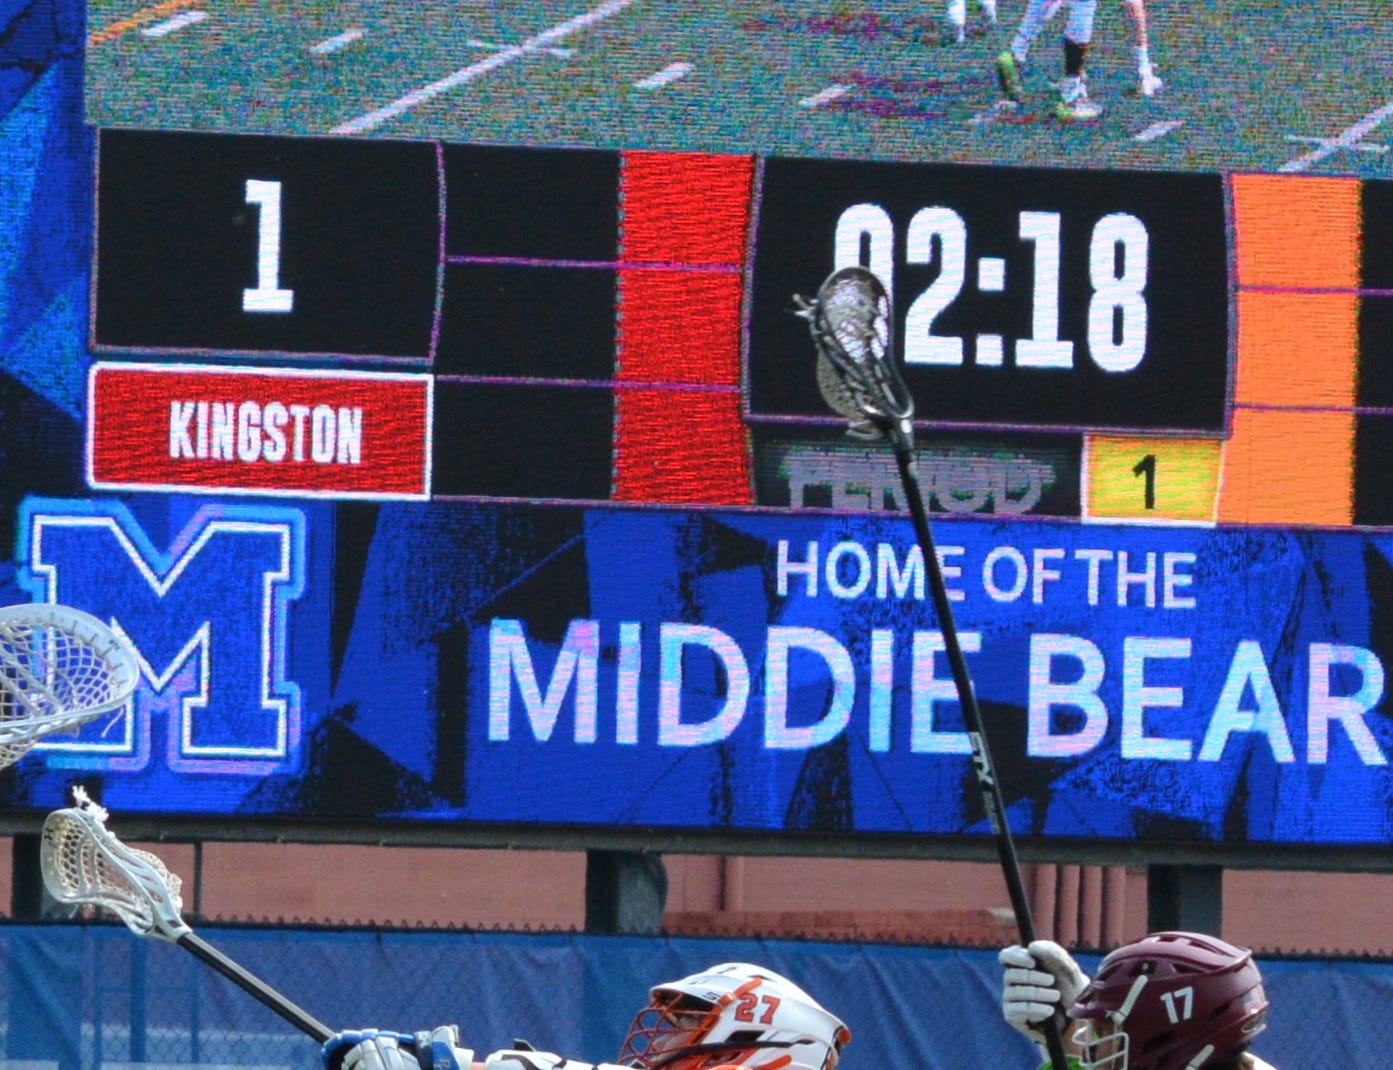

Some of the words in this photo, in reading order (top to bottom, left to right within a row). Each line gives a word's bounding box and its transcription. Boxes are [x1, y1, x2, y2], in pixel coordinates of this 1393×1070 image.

[242, 179, 295, 313] 1
[834, 202, 1149, 372] 02:18
[168, 400, 364, 465] KINGSTON
[1132, 454, 1157, 509] 1
[776, 540, 966, 601] HOME
[982, 546, 1065, 603] OF
[1075, 549, 1197, 608] THE
[16, 497, 305, 774] M
[488, 618, 983, 755] MIDDIE
[1026, 633, 1389, 765] BEAR
[734, 992, 782, 1025] 27
[1160, 986, 1193, 1024] 17
